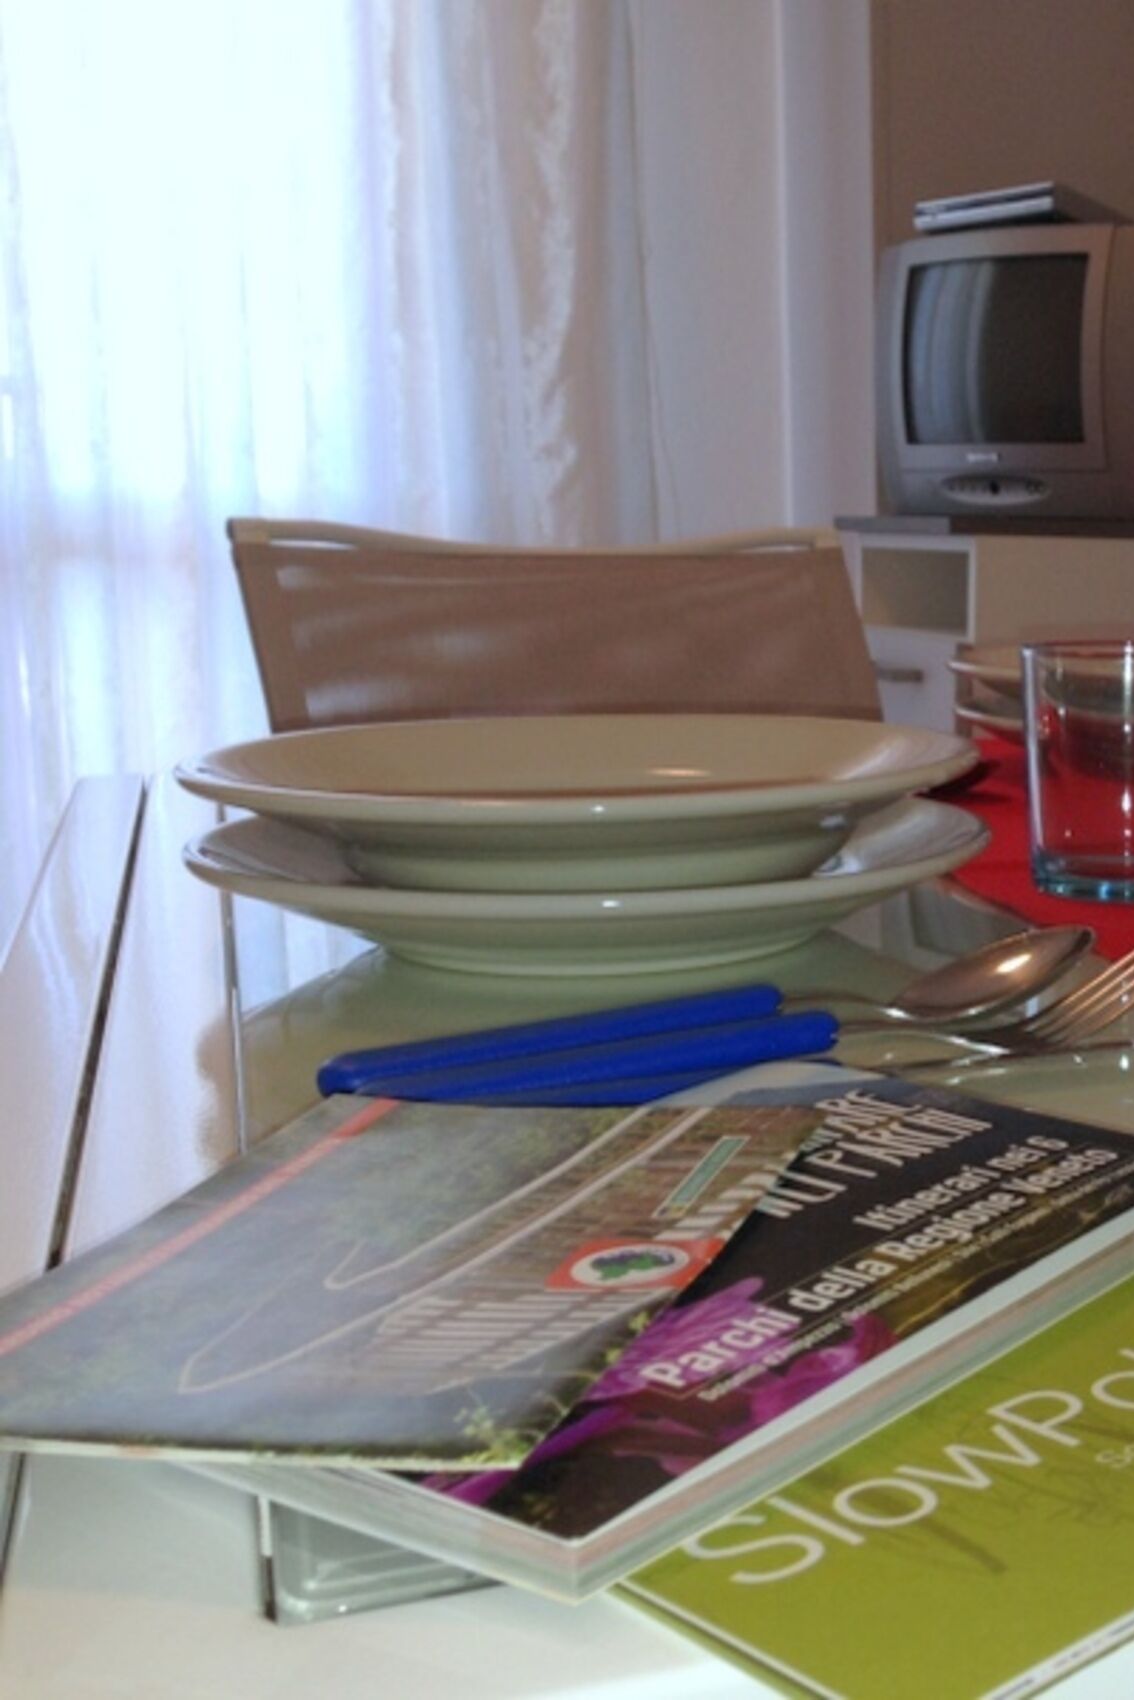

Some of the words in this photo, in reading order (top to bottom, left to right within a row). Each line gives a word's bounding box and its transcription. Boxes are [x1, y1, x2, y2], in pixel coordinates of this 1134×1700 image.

[640, 1302, 802, 1388] Parchi
[788, 1256, 900, 1313] della
[873, 1191, 1028, 1261] Regione
[1001, 1148, 1119, 1195] Veneto
[853, 1163, 1002, 1230] Itinerari
[986, 1143, 1049, 1172] nei
